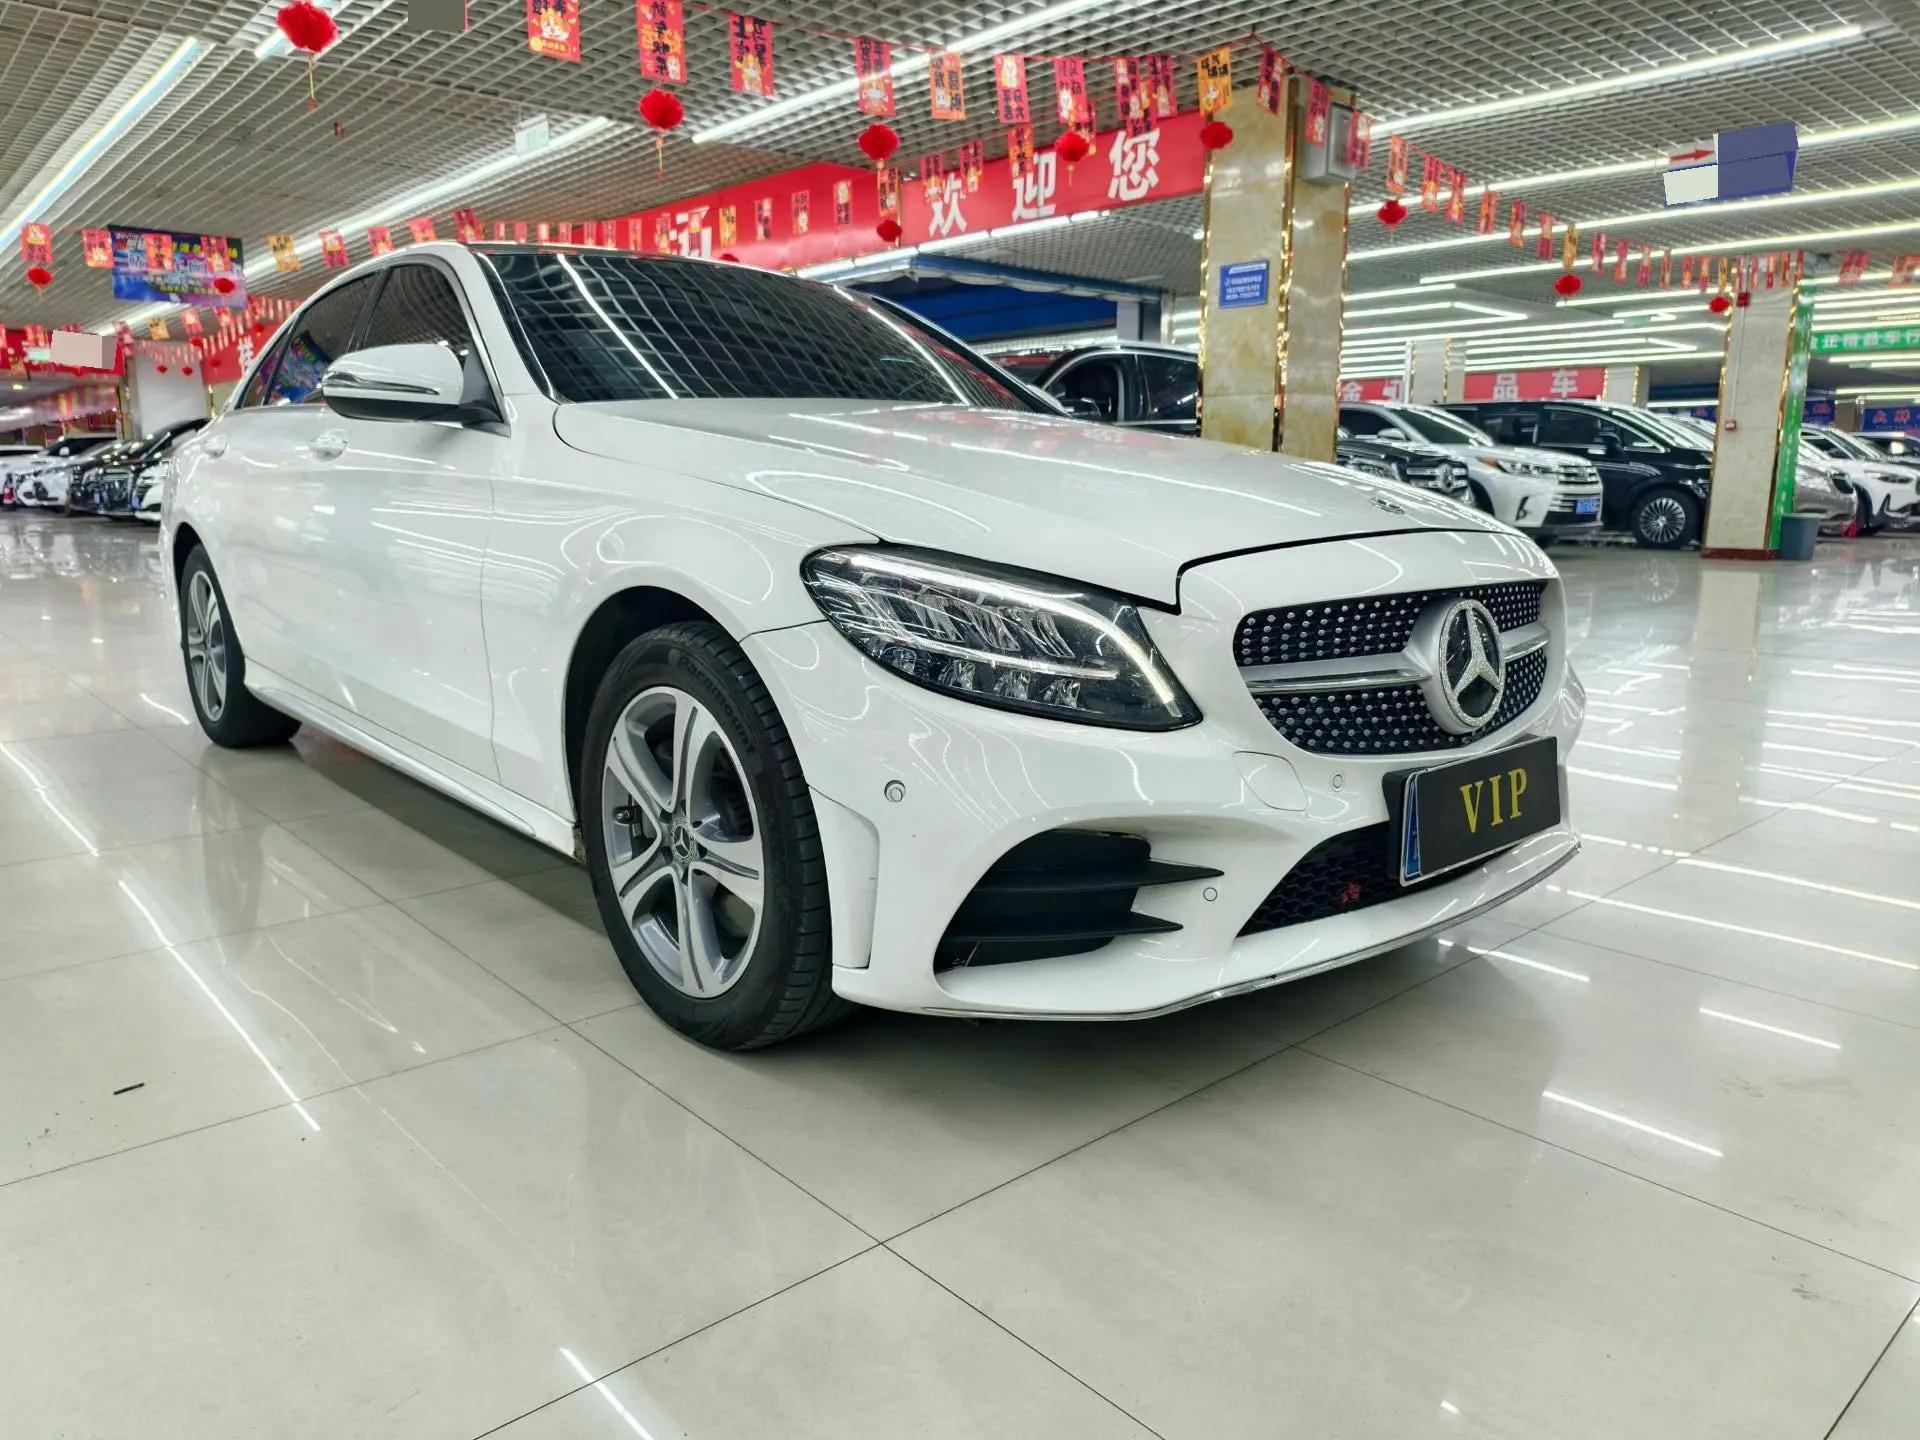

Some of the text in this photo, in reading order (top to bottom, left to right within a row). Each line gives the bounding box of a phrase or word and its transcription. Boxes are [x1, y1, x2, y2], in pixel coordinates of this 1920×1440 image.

[928, 127, 1160, 238] 欢迎您
[1459, 768, 1528, 834] VIP
